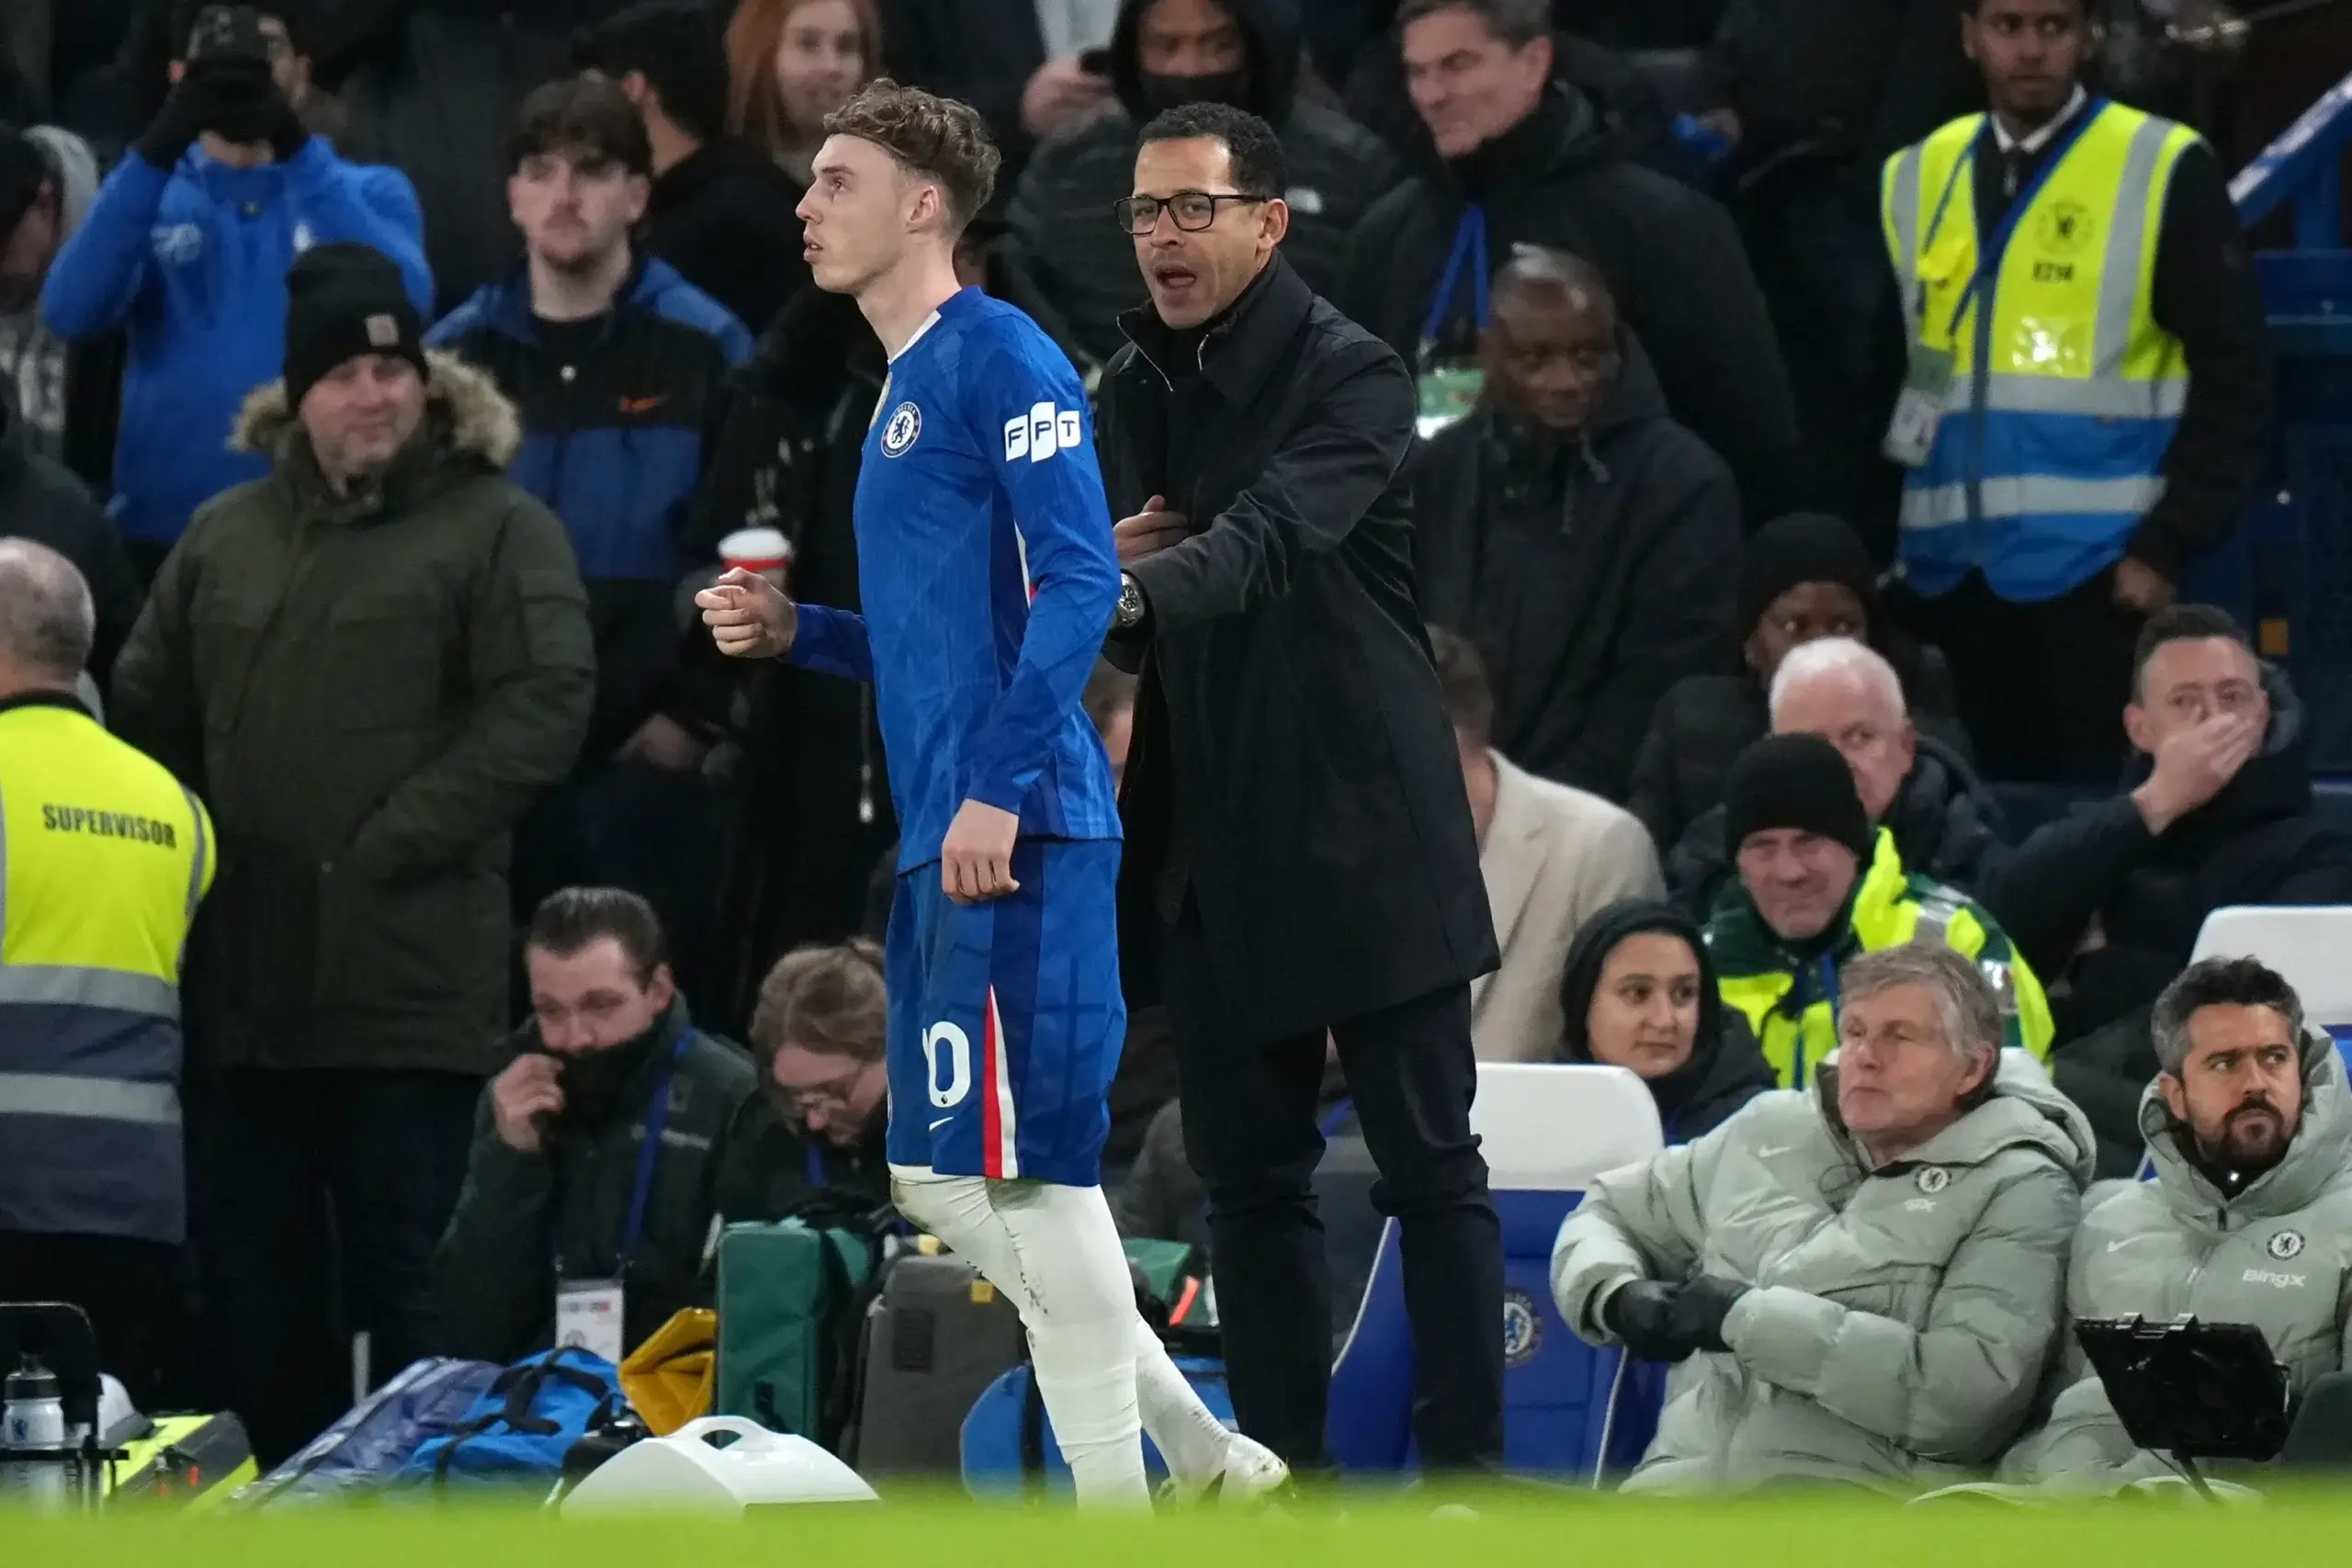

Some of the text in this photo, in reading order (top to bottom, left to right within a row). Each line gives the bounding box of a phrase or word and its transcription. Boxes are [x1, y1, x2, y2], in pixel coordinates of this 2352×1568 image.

[1008, 420, 1076, 449] FPT
[42, 803, 176, 849] SUPERVISOR
[922, 1021, 971, 1108] 0
